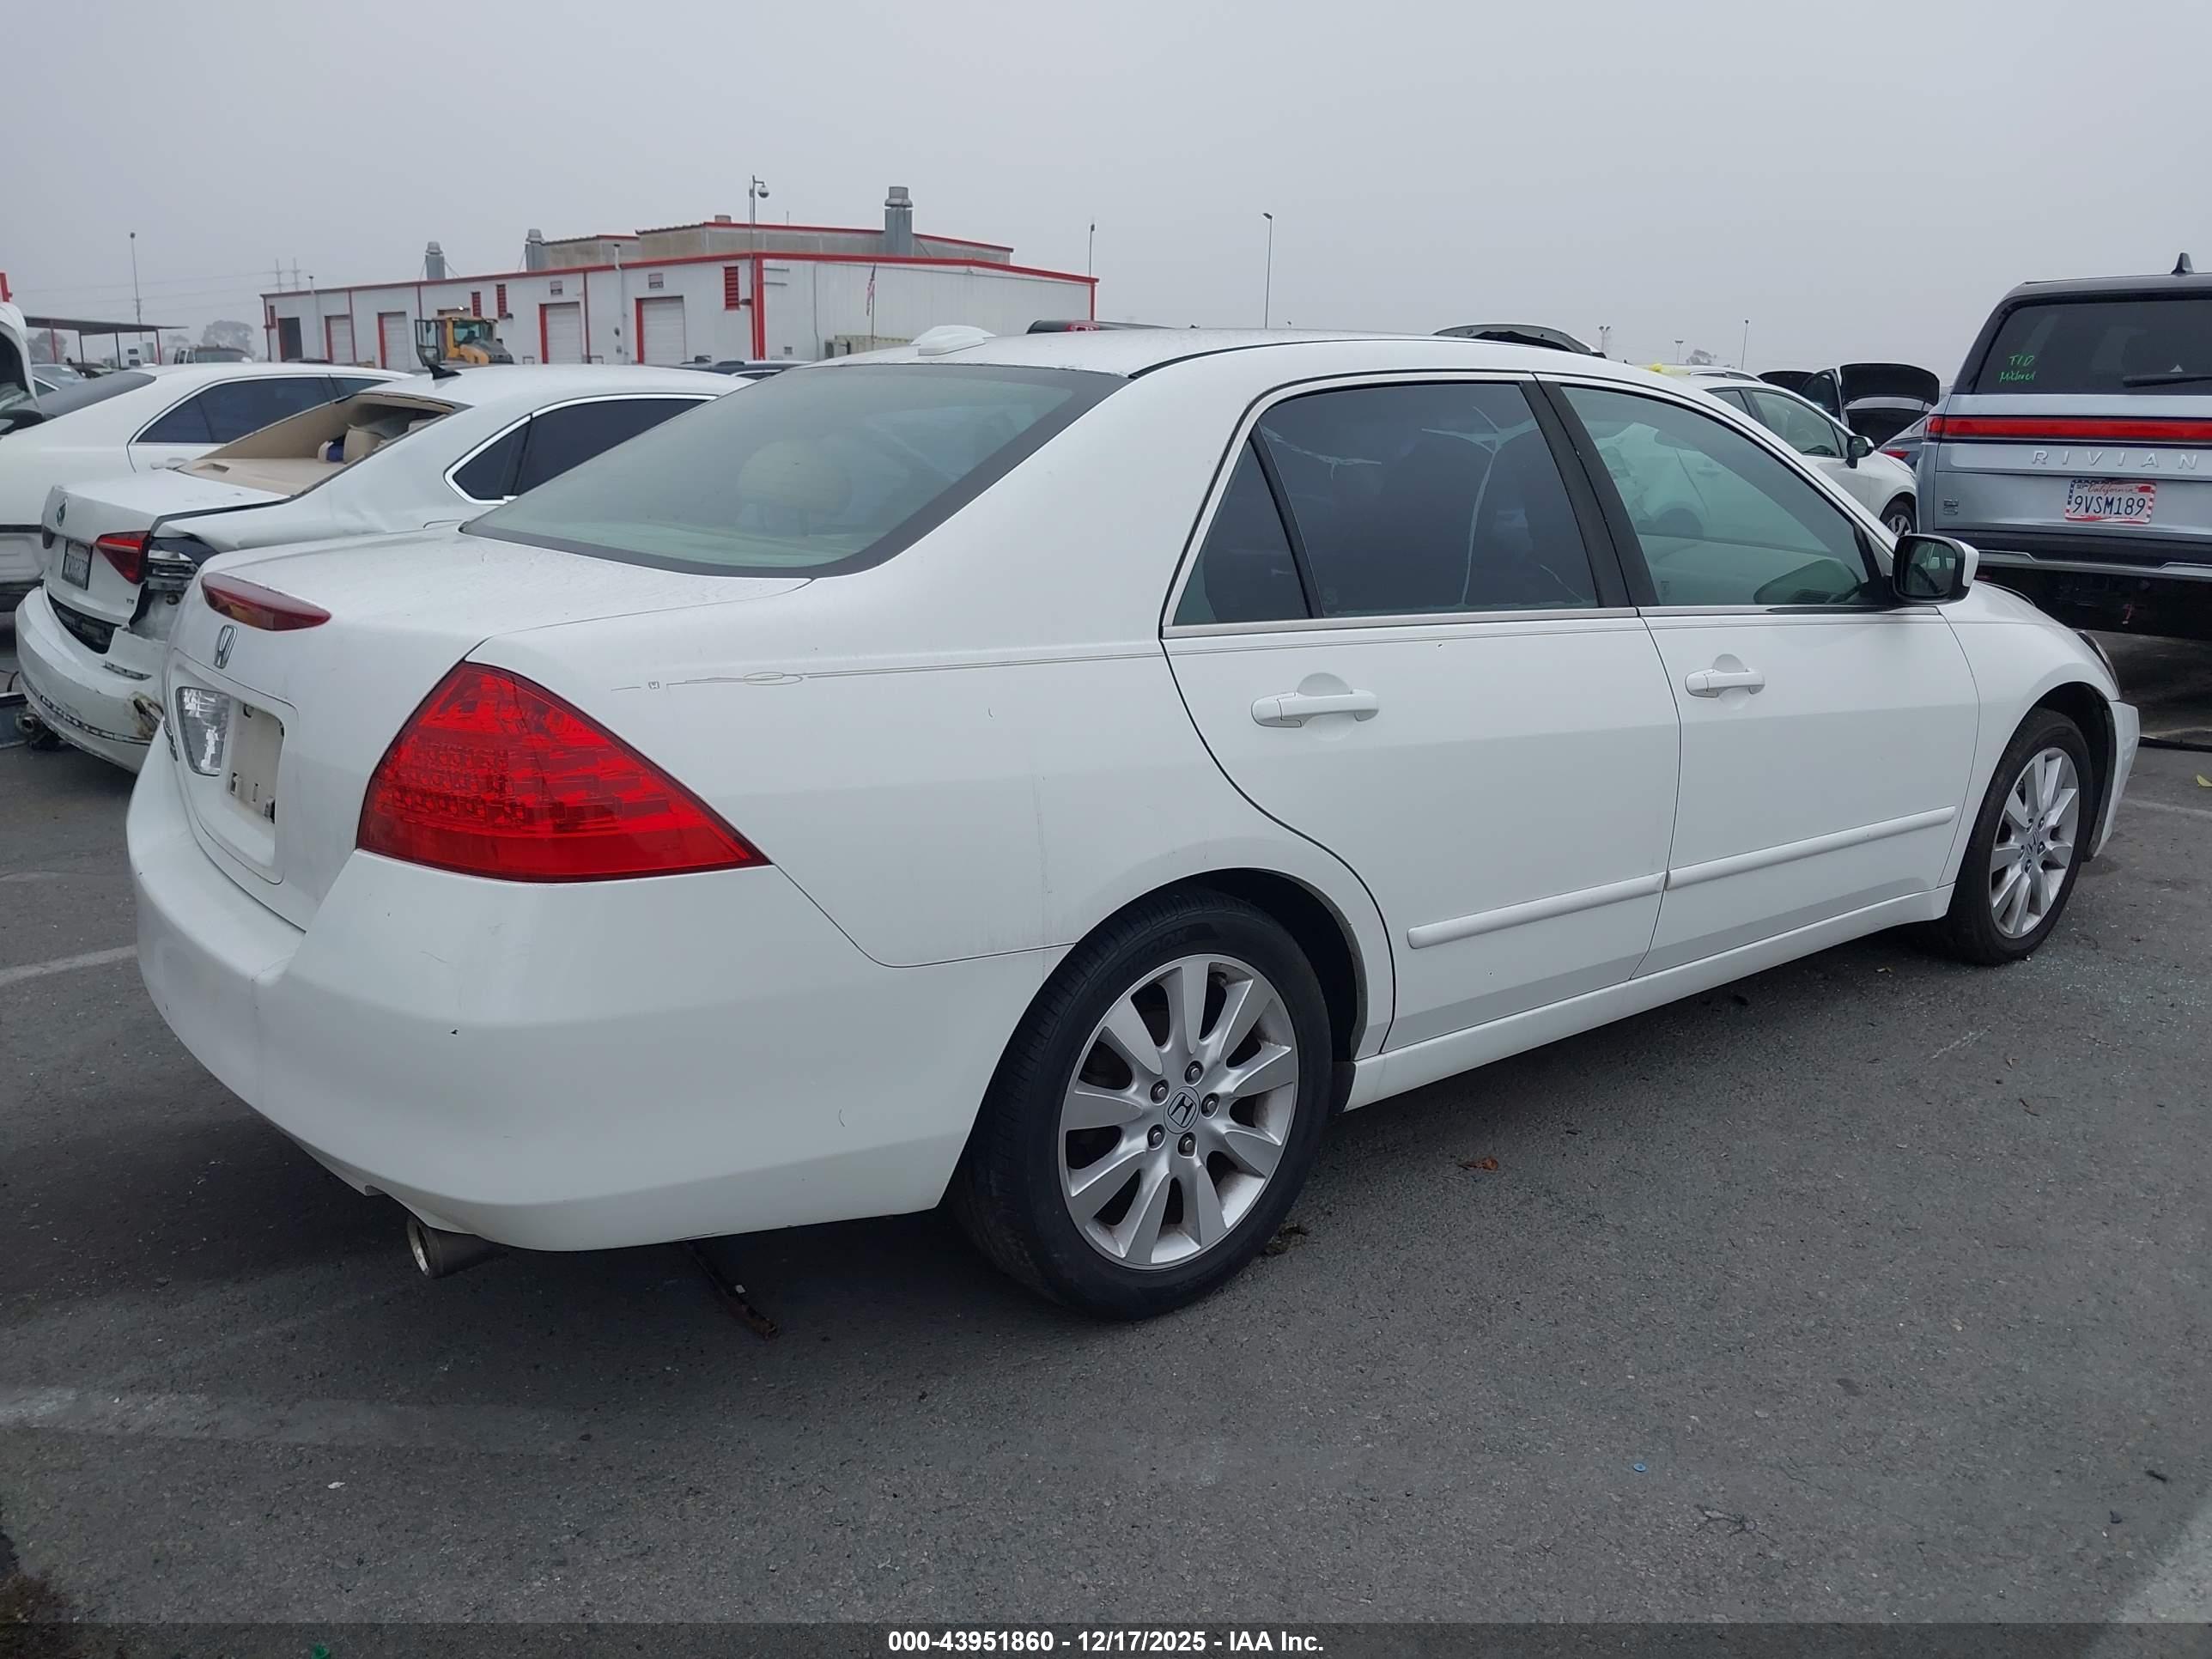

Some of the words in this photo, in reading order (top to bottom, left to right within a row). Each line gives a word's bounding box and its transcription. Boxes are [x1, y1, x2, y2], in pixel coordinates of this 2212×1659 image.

[2032, 450, 2198, 470] RIVIAN
[2087, 483, 2134, 495] California
[2072, 495, 2147, 516] 9VSM189
